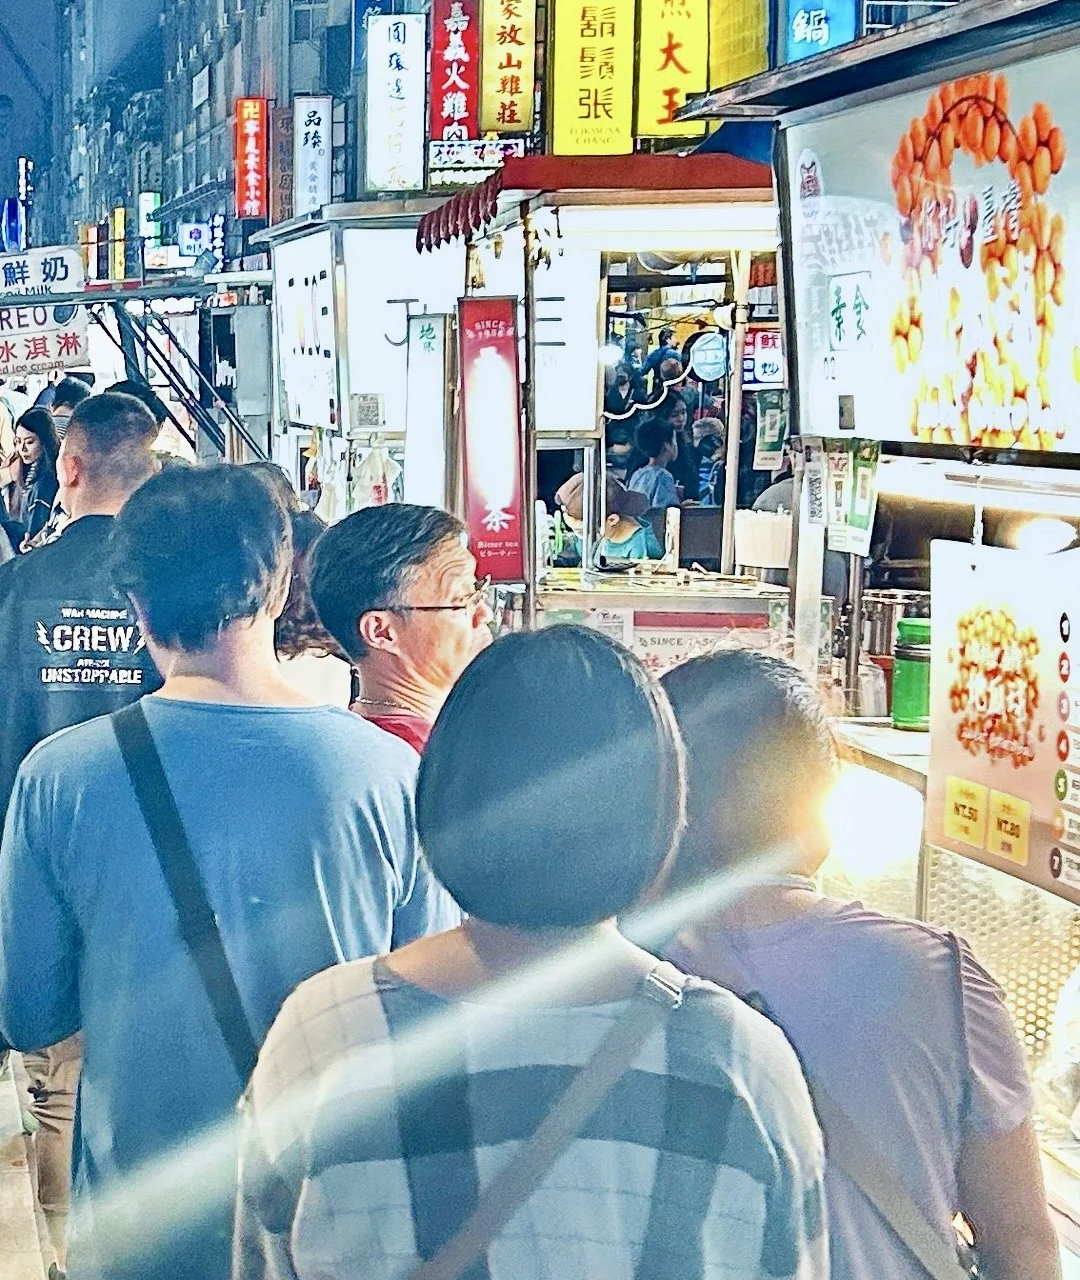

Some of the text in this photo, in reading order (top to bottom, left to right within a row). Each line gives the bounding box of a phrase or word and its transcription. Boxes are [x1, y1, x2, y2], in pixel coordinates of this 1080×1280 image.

[577, 6, 616, 120] 鬍鬚張
[24, 284, 52, 296] Milk
[474, 320, 506, 331] SINCE
[52, 625, 134, 652] CREW
[649, 637, 683, 647] SINCE
[40, 668, 143, 685] UNSTOPPABLE
